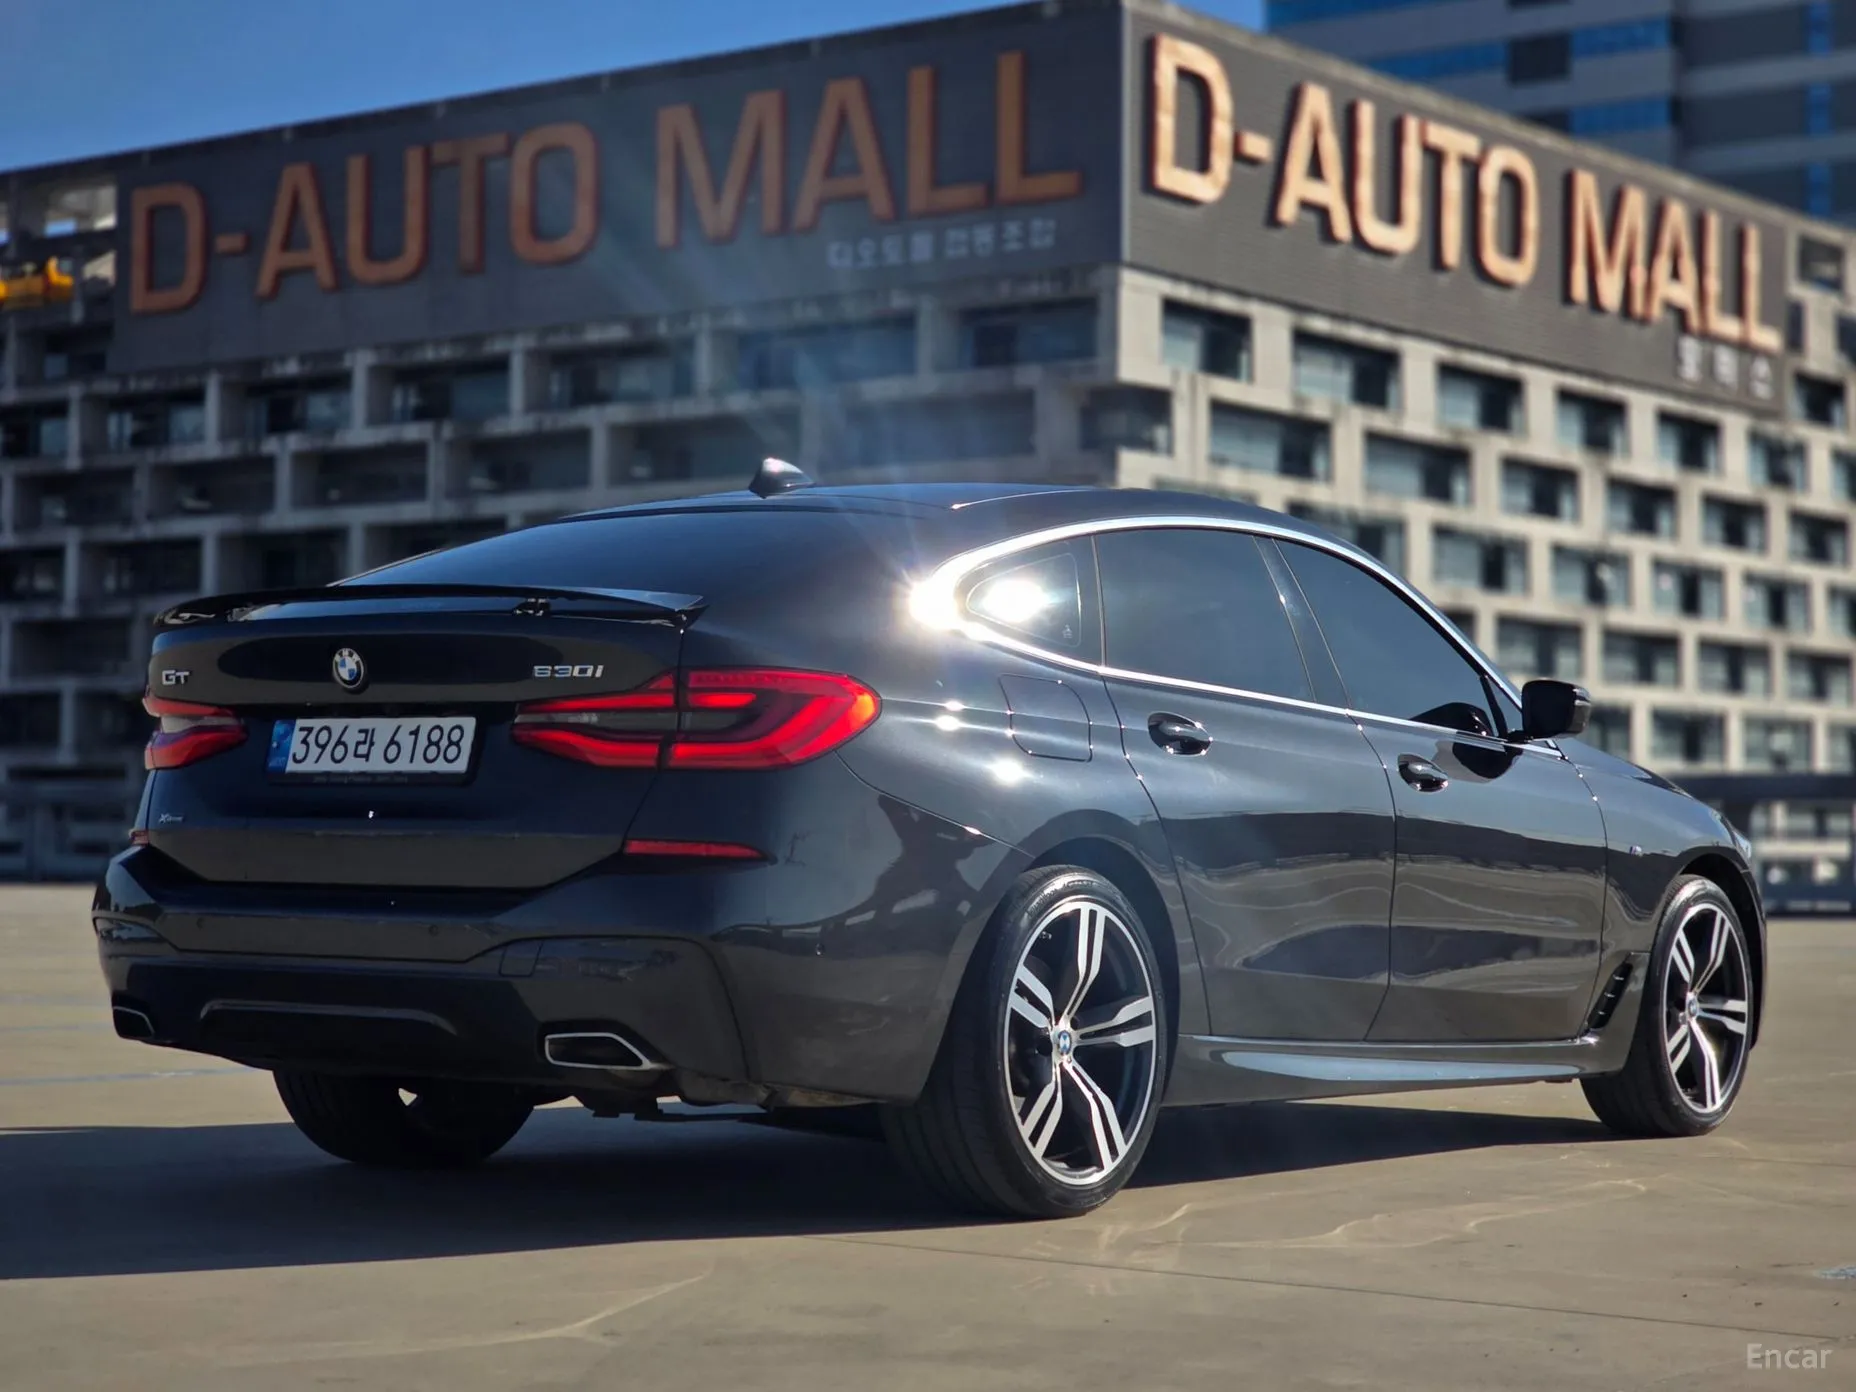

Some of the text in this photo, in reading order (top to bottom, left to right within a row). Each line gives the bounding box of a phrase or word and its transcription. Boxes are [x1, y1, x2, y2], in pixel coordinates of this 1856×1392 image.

[129, 50, 1083, 314] D-AUTO MALL
[1150, 33, 1780, 352] D-AUTO MALL
[161, 669, 190, 686] GT
[292, 724, 465, 764] 396라 6188
